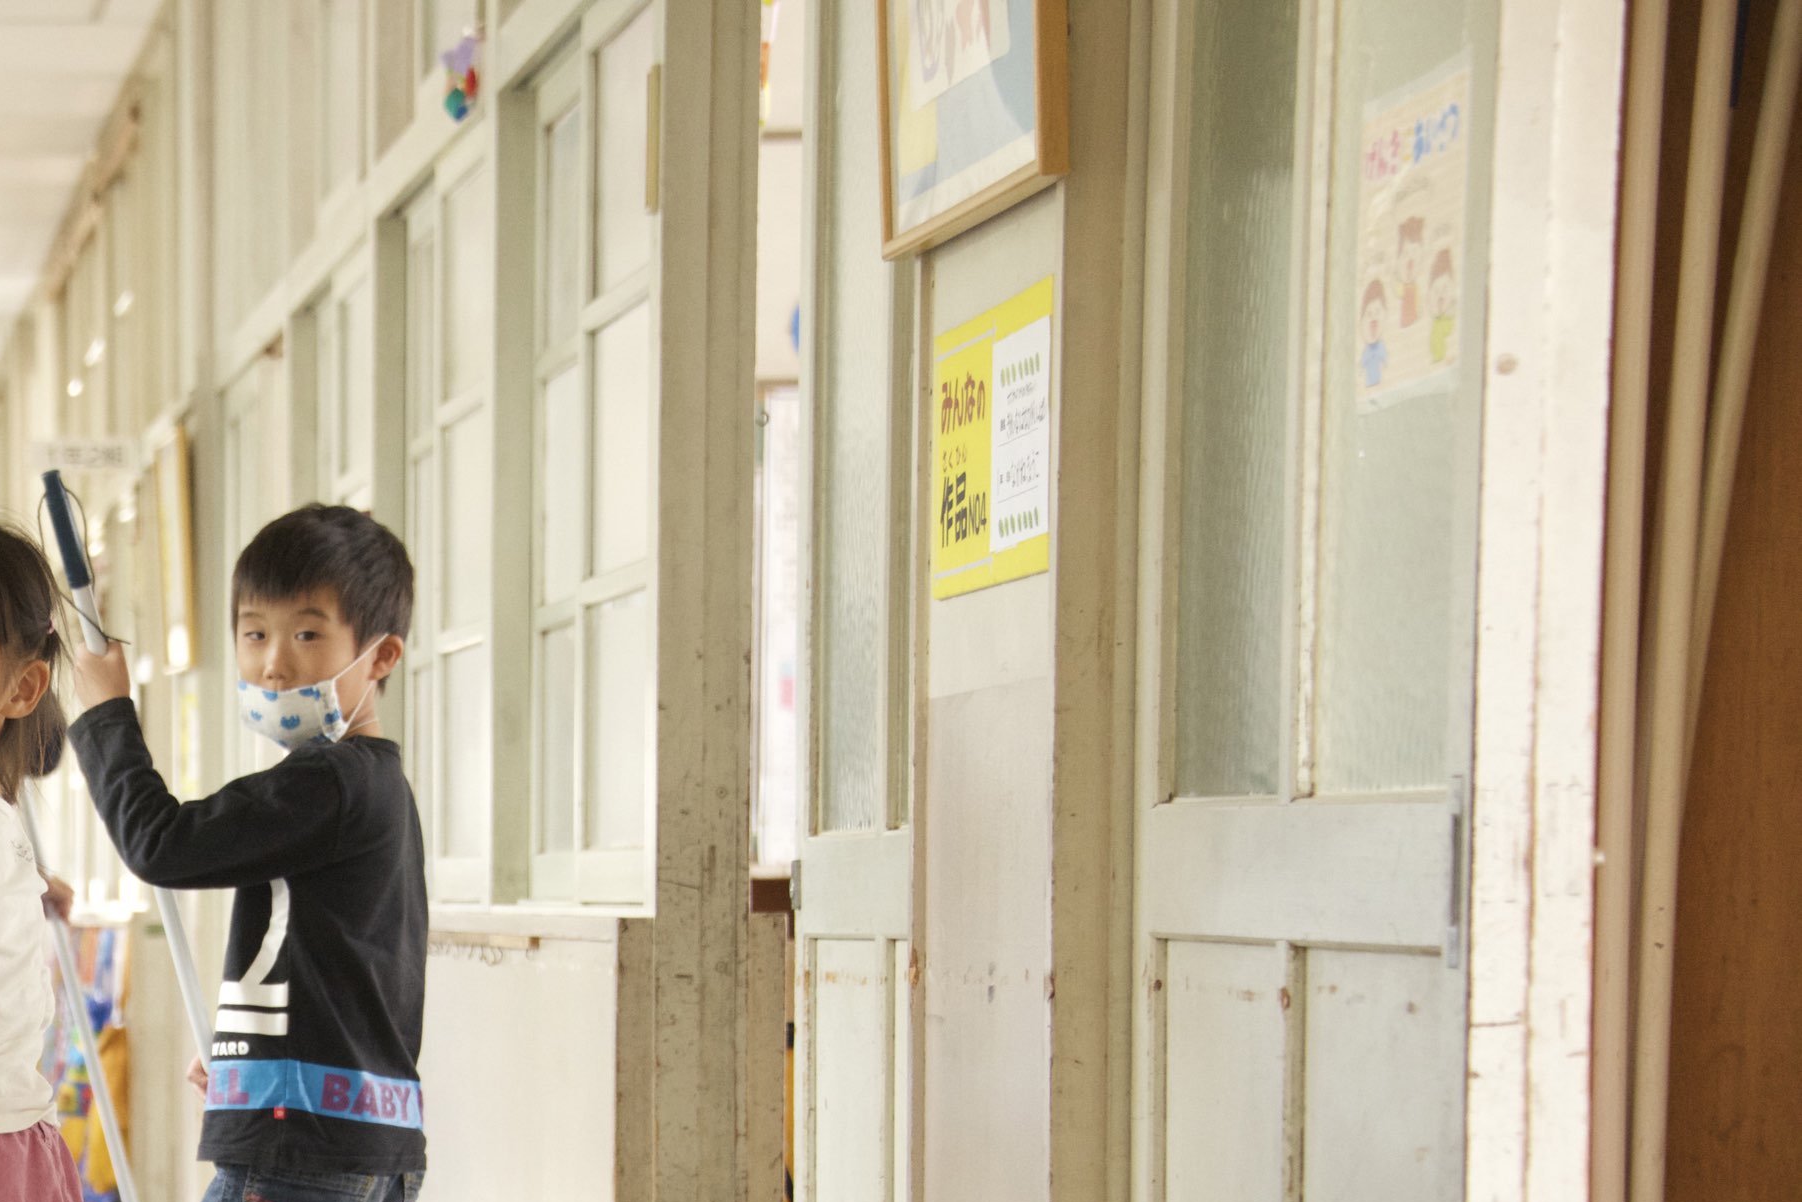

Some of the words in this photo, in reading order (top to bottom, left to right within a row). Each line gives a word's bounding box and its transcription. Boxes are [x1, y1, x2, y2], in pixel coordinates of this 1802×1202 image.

[941, 371, 986, 435] みんなの
[320, 1073, 411, 1122] BABY
